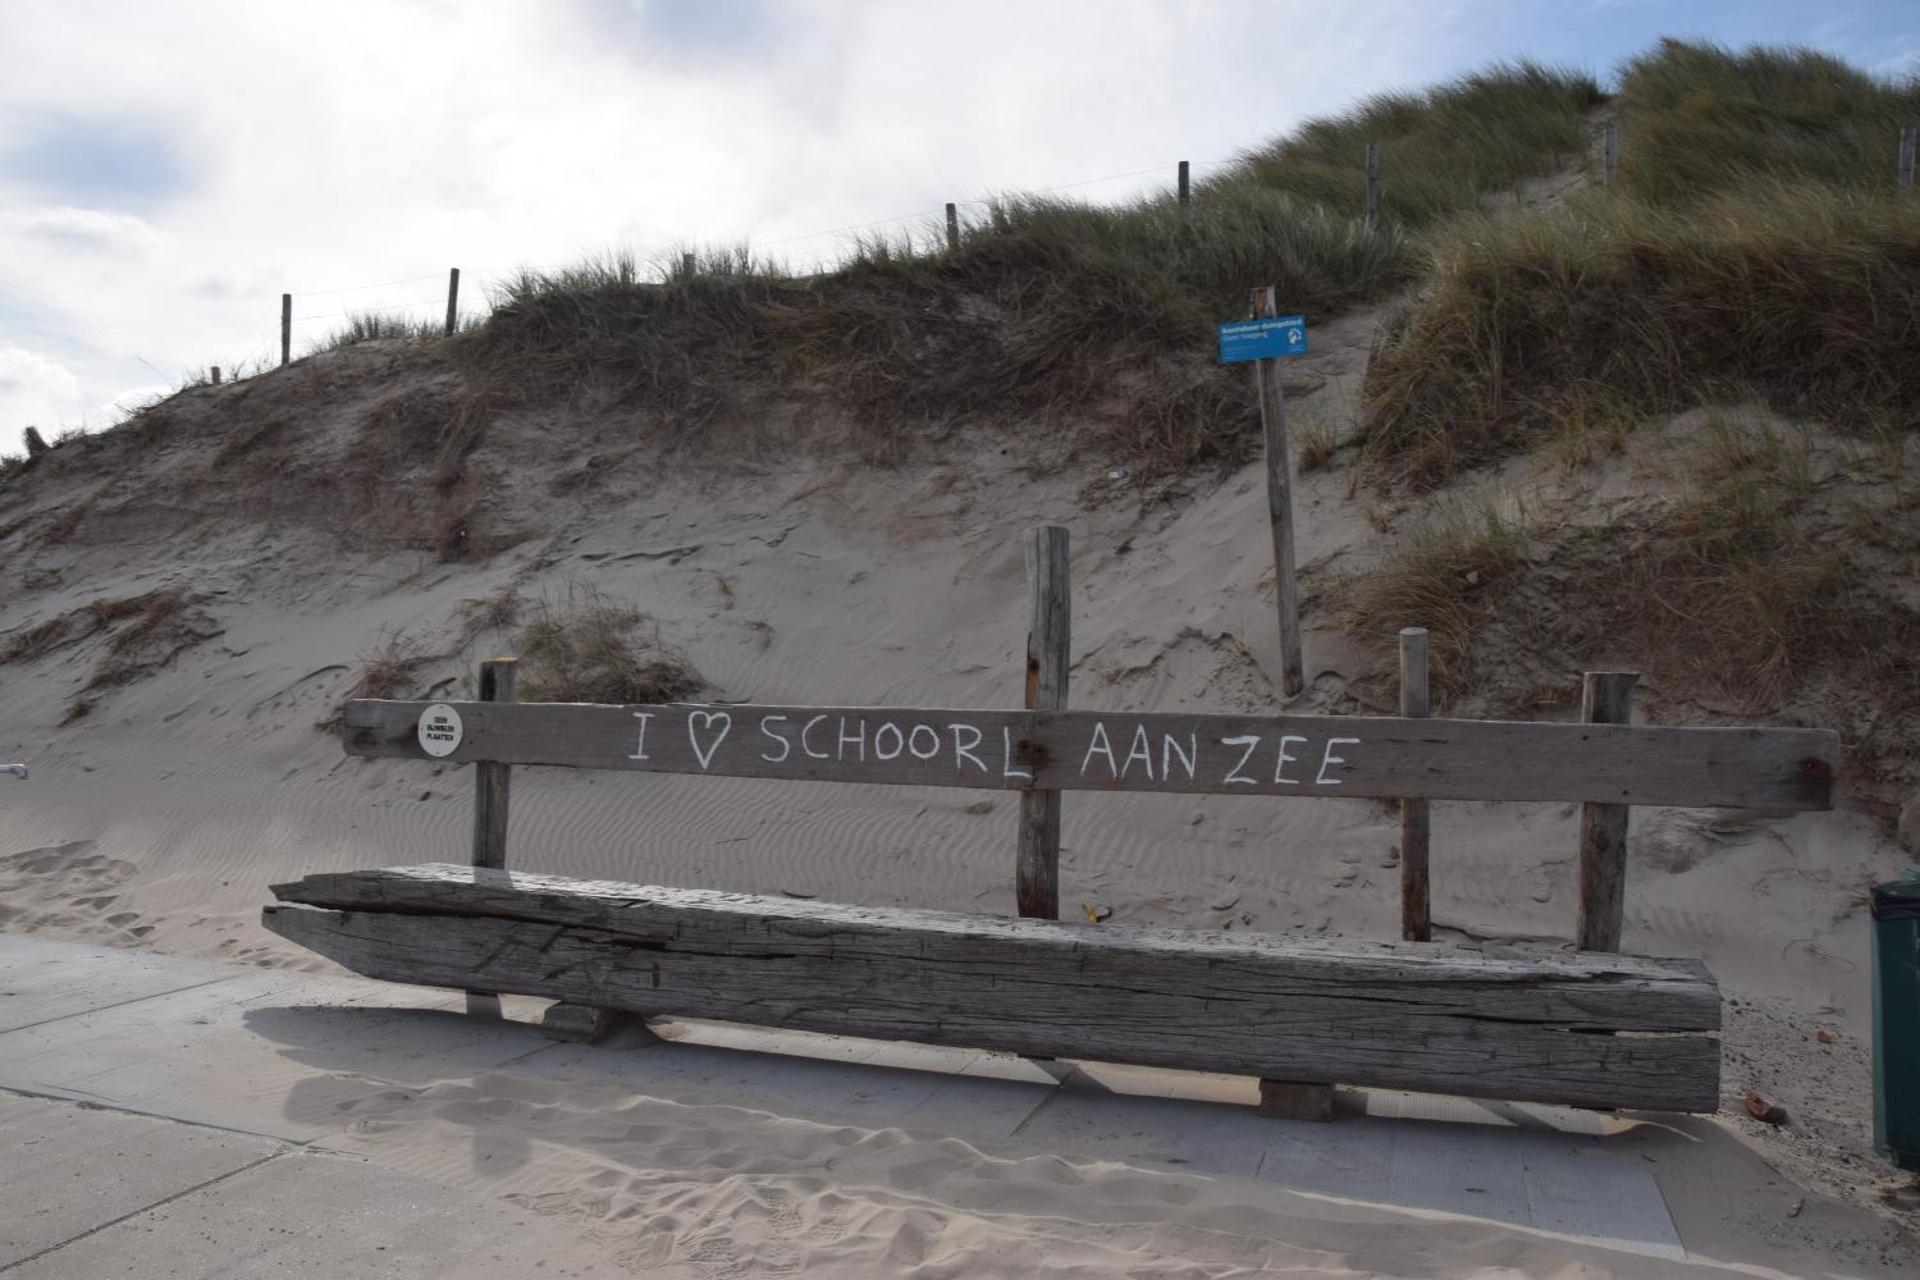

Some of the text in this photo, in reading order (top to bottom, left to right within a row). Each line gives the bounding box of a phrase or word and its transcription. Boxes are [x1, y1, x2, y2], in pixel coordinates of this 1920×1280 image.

[628, 711, 1361, 785] I SCHOORL AAN ZEE
